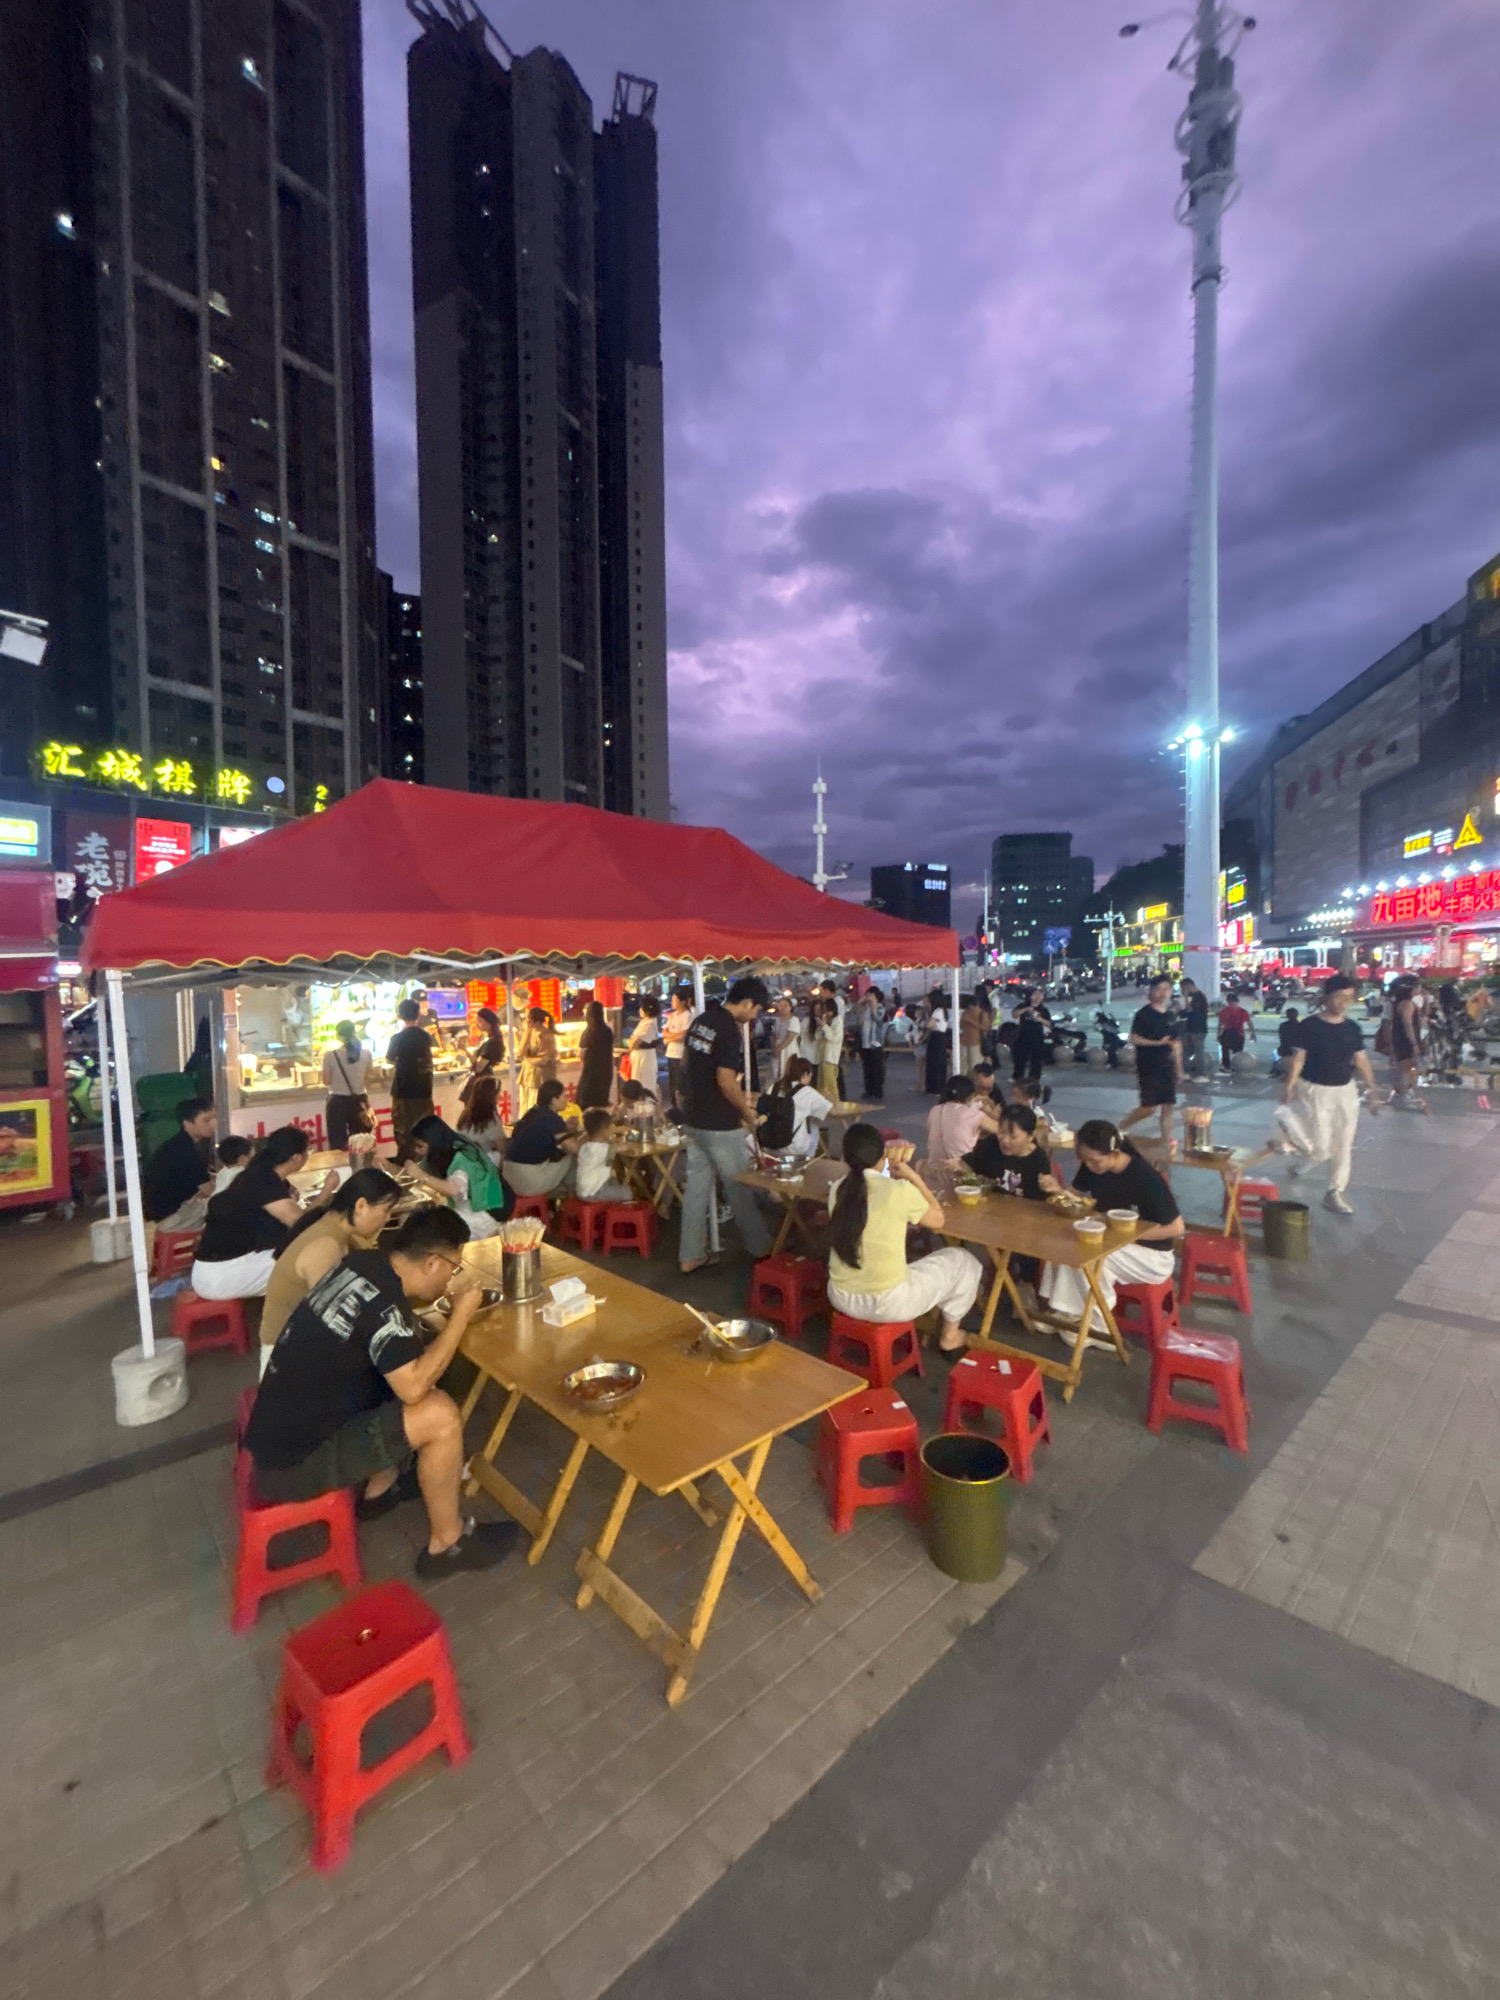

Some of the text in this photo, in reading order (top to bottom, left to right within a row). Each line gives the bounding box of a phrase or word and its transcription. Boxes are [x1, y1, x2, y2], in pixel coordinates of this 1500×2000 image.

[43, 742, 252, 805] 汇城棋牌
[1371, 882, 1445, 924] 九亩地
